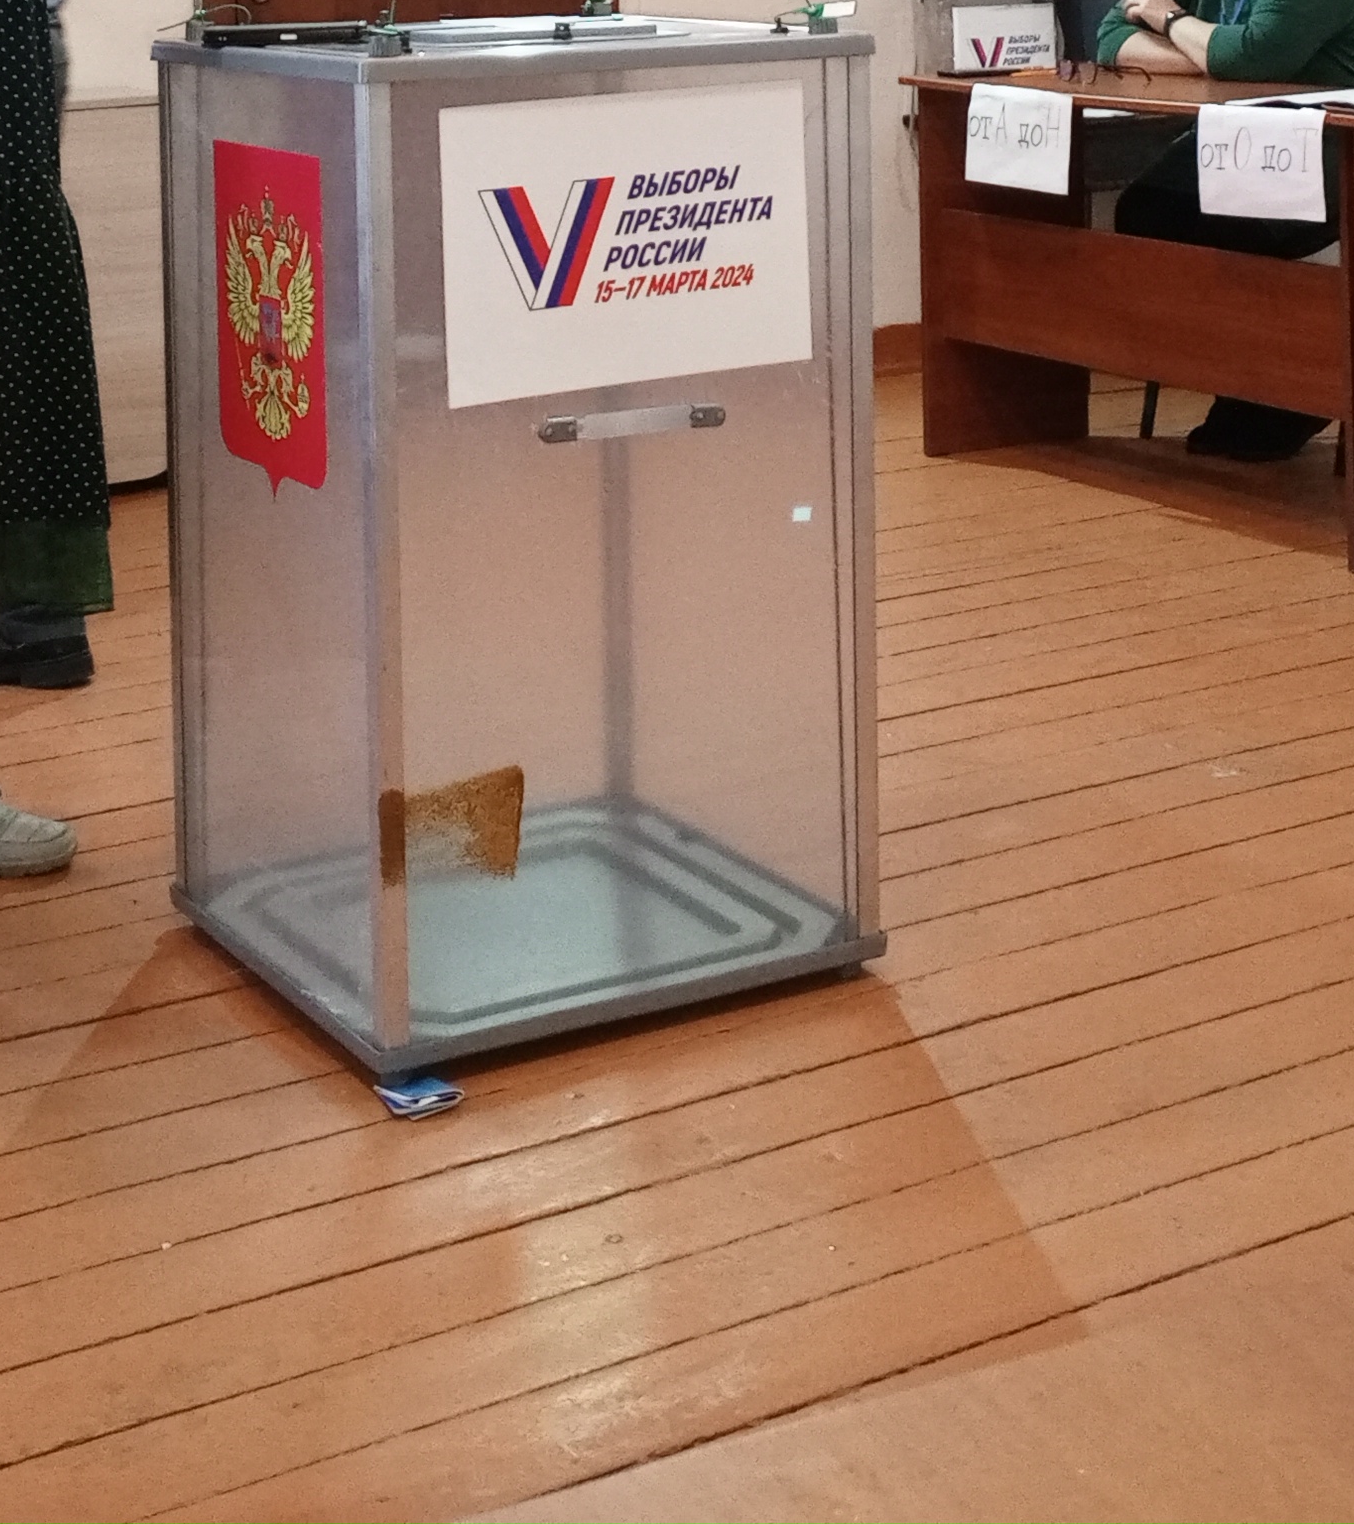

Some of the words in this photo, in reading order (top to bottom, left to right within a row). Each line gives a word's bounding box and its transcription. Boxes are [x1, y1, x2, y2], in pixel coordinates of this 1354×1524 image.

[1006, 44, 1050, 56] ПРЕЗИДЕНТА
[1008, 34, 1041, 45] ВЫБОРЫ
[1002, 56, 1031, 67] РОССИИ
[627, 165, 741, 200] ВЫБОРЫ
[615, 195, 773, 236] ПРЕЗИДЕНТА
[603, 236, 708, 272] РОССИИ
[646, 269, 708, 297] МАРТА
[710, 263, 756, 290] 2024
